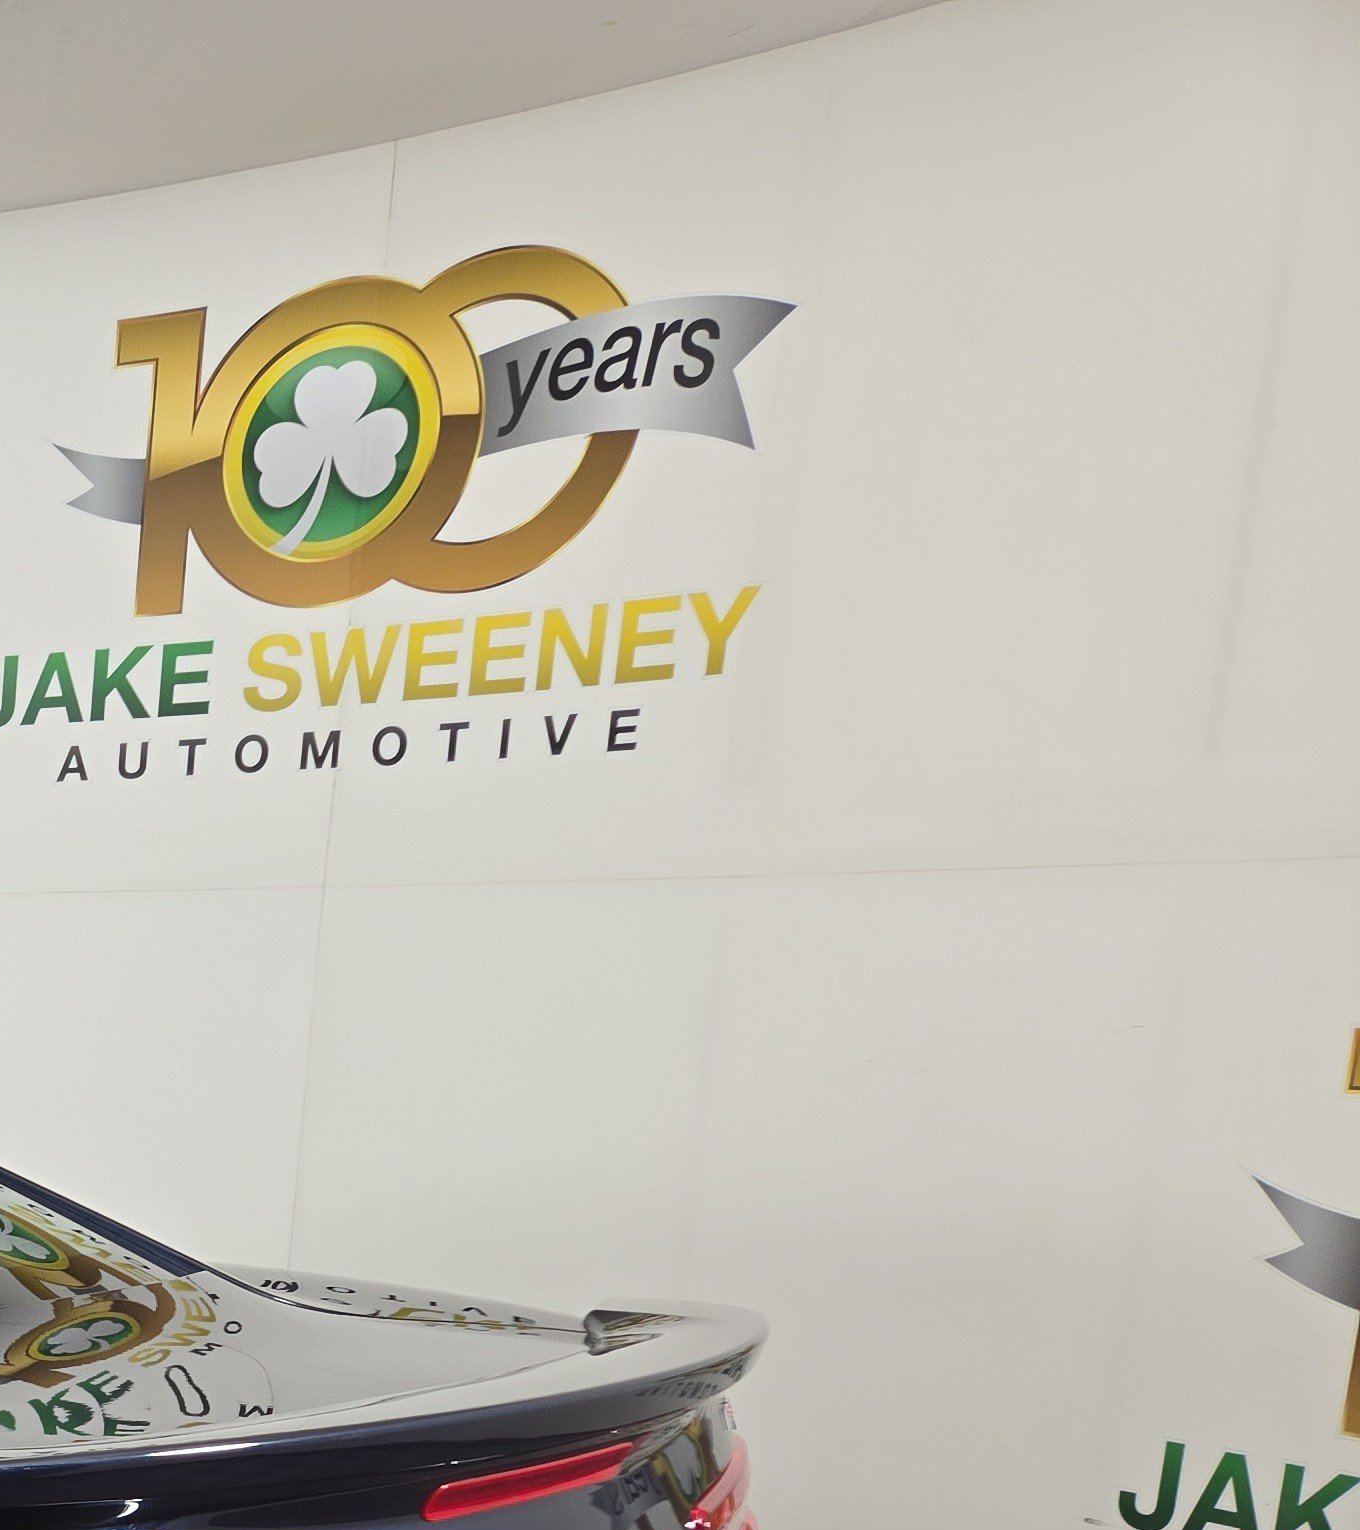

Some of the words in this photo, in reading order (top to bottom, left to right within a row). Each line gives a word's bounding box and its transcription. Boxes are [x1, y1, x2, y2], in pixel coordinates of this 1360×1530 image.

[496, 315, 721, 437] years
[244, 585, 761, 712] SWEENEY
[57, 708, 642, 782] AUTOMOTIVE
